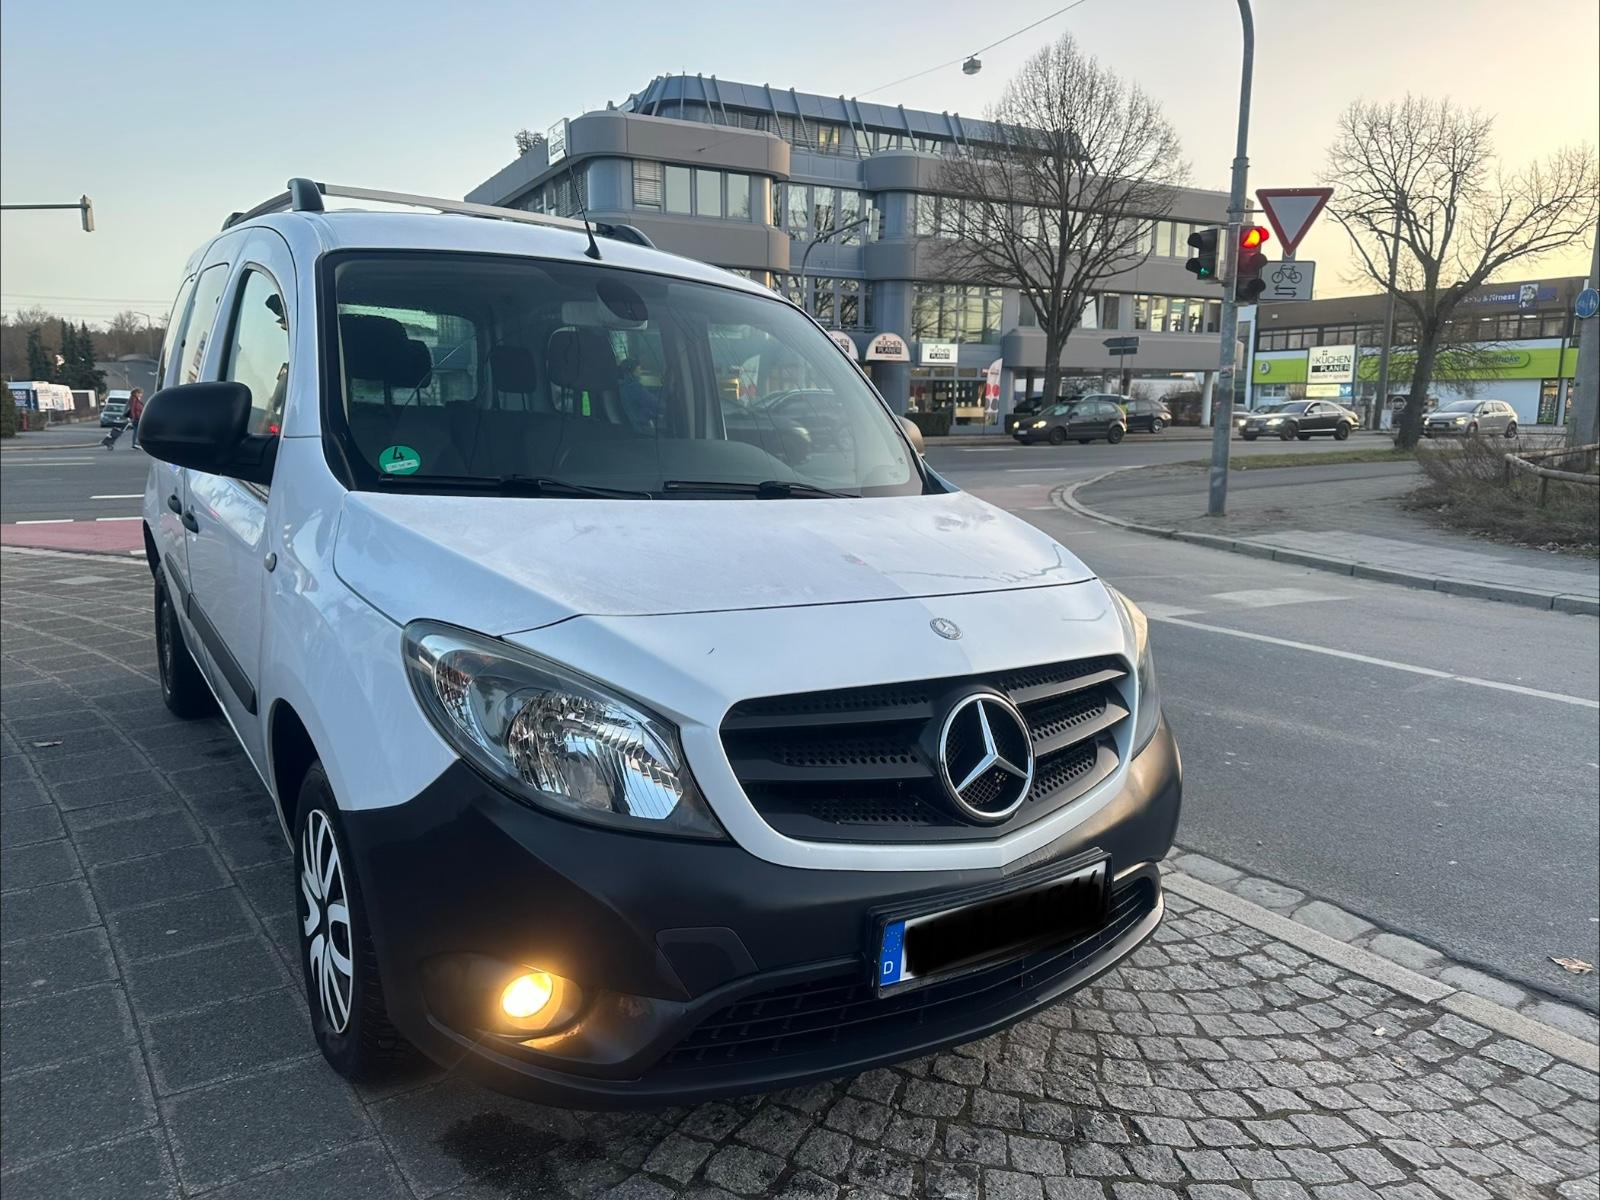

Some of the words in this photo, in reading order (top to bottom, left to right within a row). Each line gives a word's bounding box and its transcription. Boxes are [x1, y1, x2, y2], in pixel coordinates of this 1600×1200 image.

[877, 346, 902, 354] PLANER
[1321, 364, 1351, 372] PLANER
[393, 446, 405, 460] 4
[883, 960, 894, 975] D
